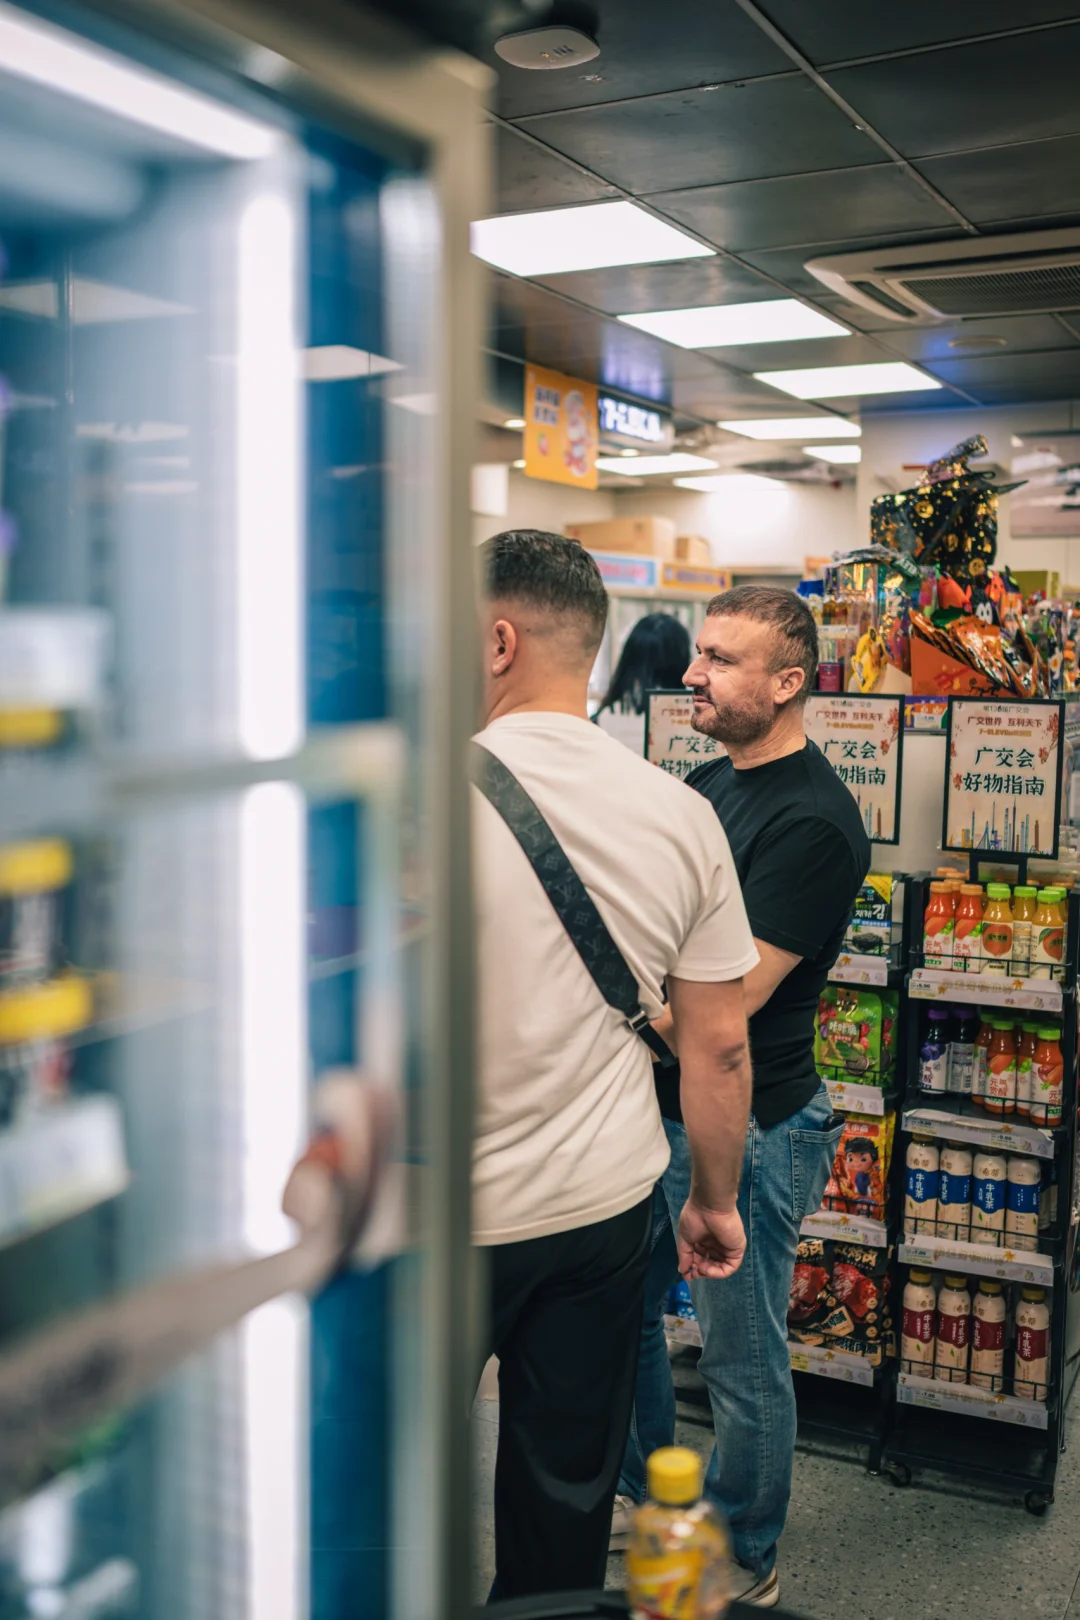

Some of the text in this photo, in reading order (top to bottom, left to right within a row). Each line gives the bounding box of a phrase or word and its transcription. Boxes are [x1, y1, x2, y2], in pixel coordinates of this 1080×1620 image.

[815, 710, 847, 720] 广交世界
[967, 715, 1043, 728] 广交世界 互利天下
[668, 735, 717, 754] 广交会
[823, 739, 877, 760] 广交会
[974, 747, 1035, 768] 广交会
[963, 773, 1045, 796] 好物指南
[915, 1173, 925, 1199] 牛乳茶
[941, 1175, 949, 1201] 牛乳茶
[985, 1183, 995, 1209] 牛乳茶
[923, 1314, 932, 1340] 牛乳茶
[957, 1319, 966, 1345] 牛乳茶
[1022, 1331, 1032, 1358] 牛乳茶
